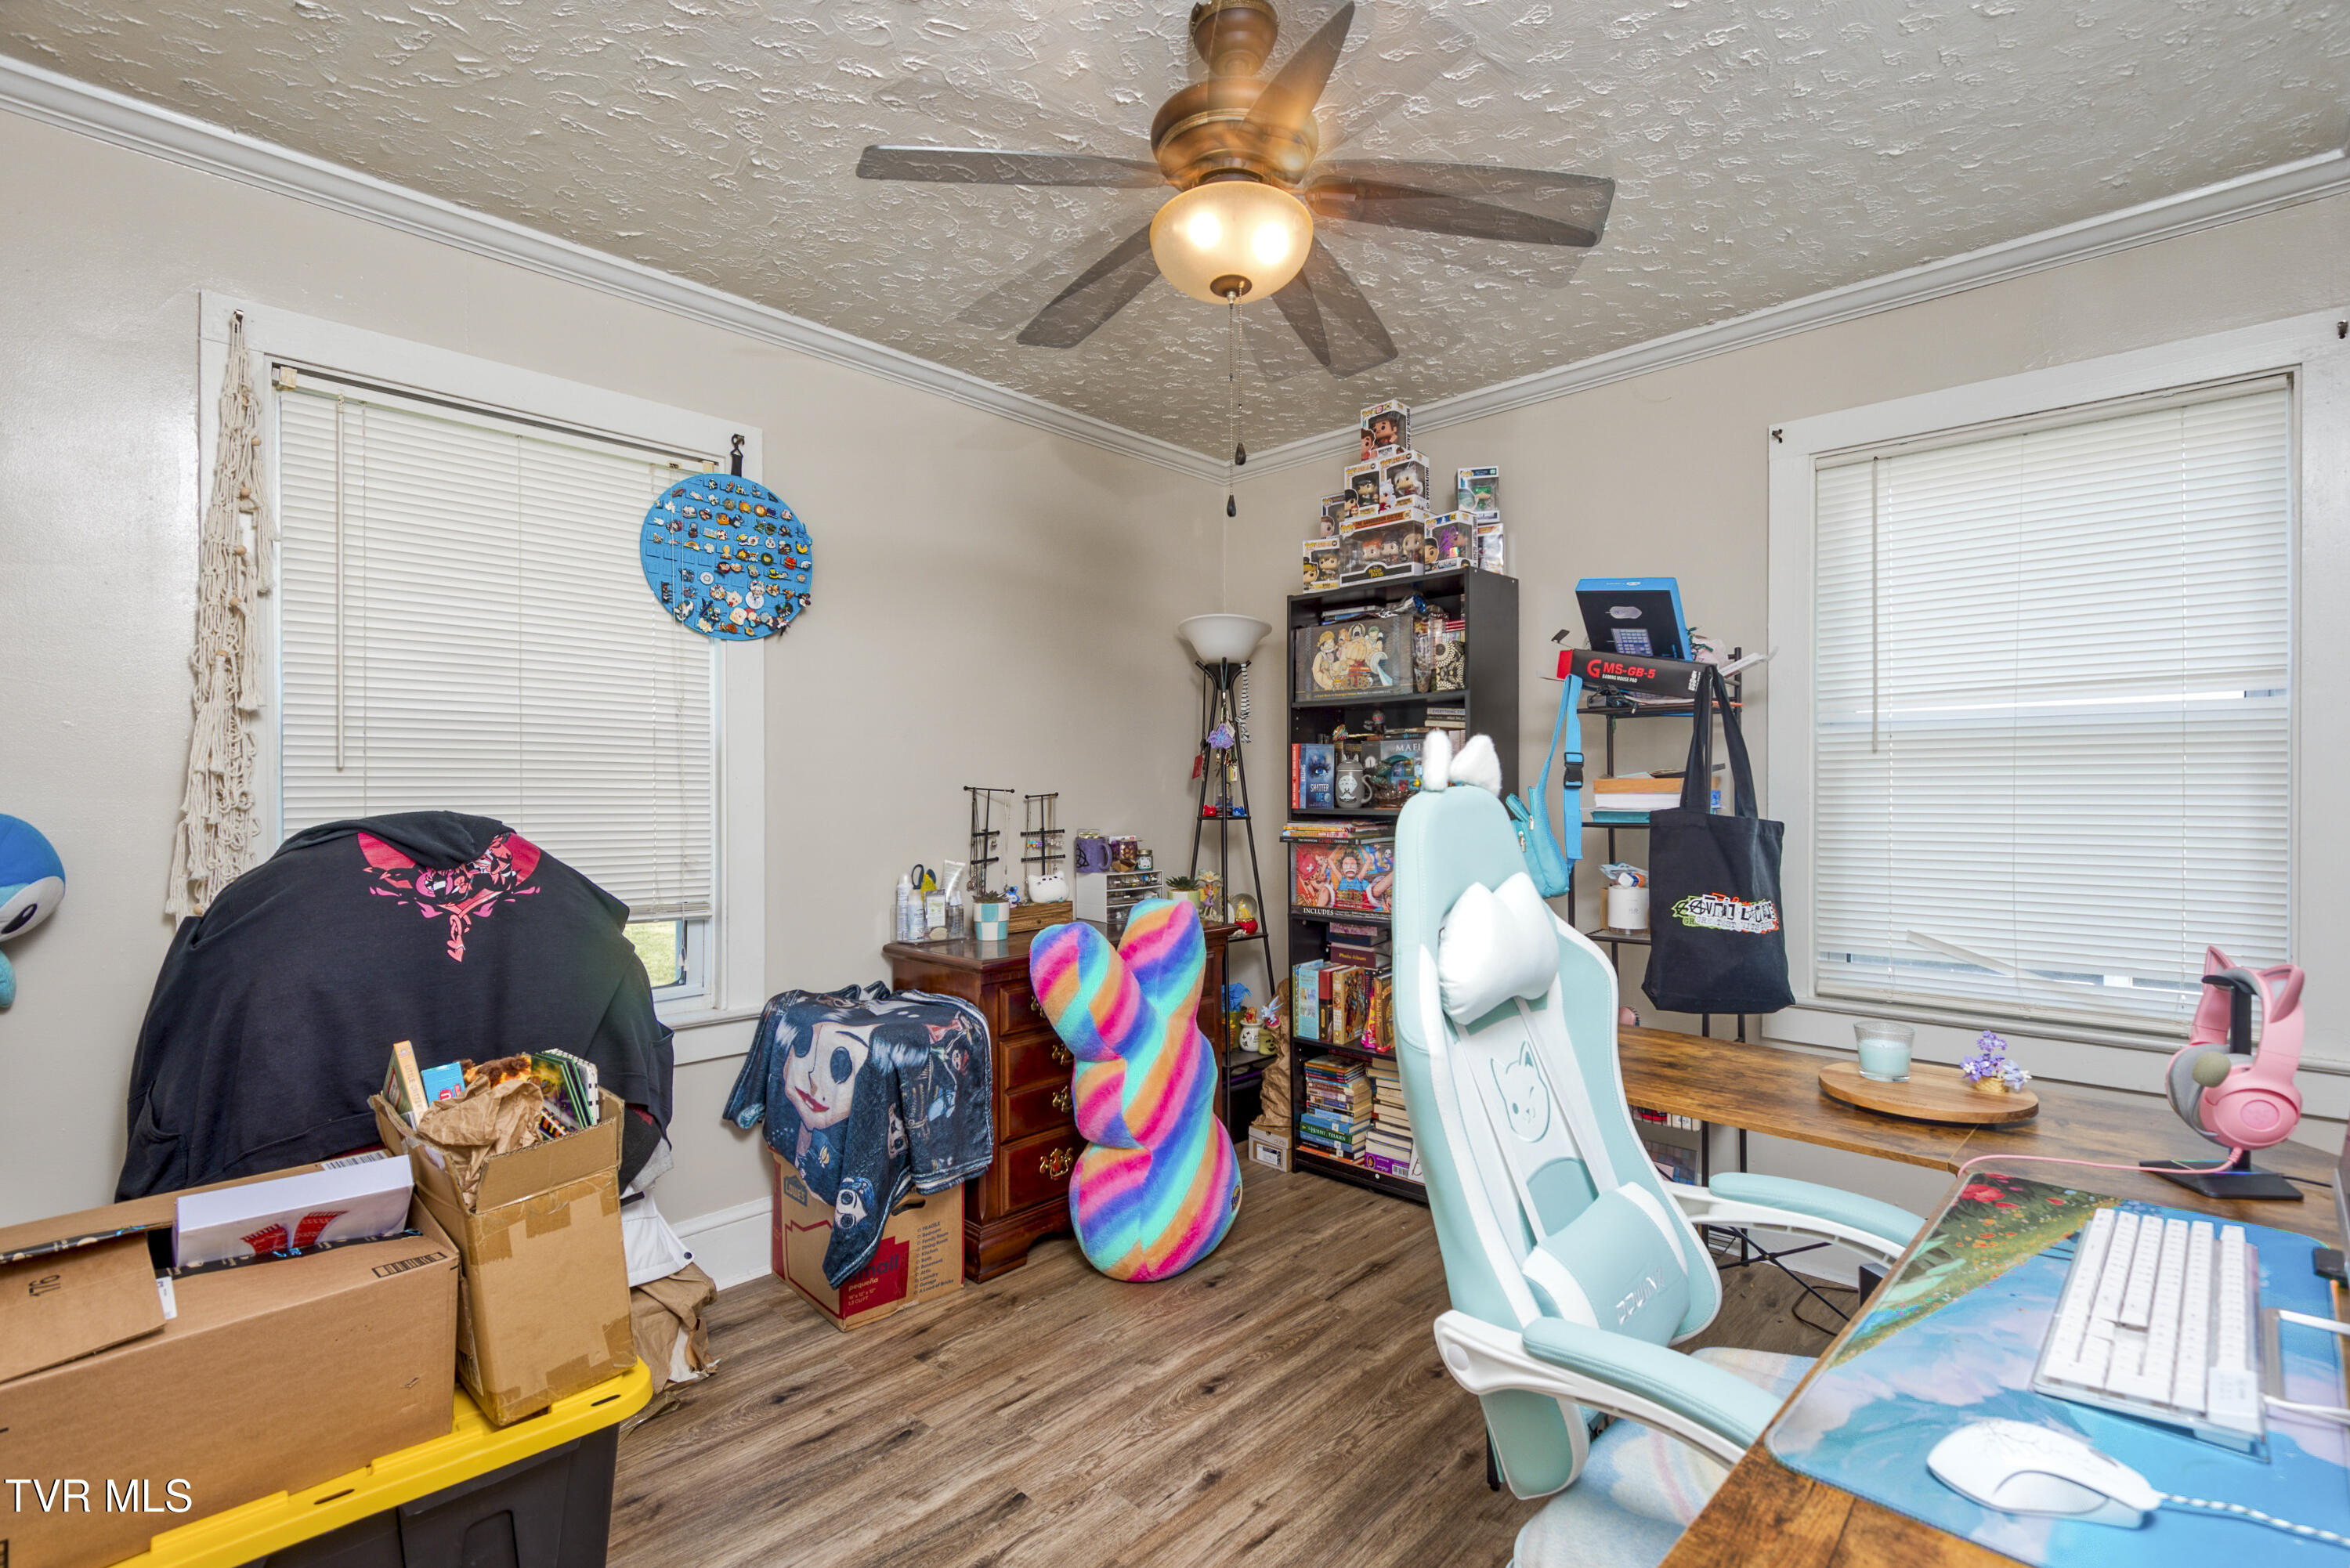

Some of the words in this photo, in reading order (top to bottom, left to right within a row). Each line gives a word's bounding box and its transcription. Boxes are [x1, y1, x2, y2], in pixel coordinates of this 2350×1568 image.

[1603, 661, 1656, 679] MS-GB-5
[1310, 783, 1329, 793] SHATTER
[1303, 907, 1334, 916] INCLUDES
[1311, 1127, 1326, 1137] HOBBIT
[1328, 1132, 1346, 1141] TOLKIEN
[922, 1222, 941, 1231] FRAGILE
[922, 1228, 942, 1237] Bedroom
[921, 1248, 938, 1256] Kitchen
[920, 1258, 943, 1269] Basement
[920, 1273, 938, 1281] Laundry
[848, 1277, 879, 1292] pequeña
[920, 1279, 937, 1288] Garage
